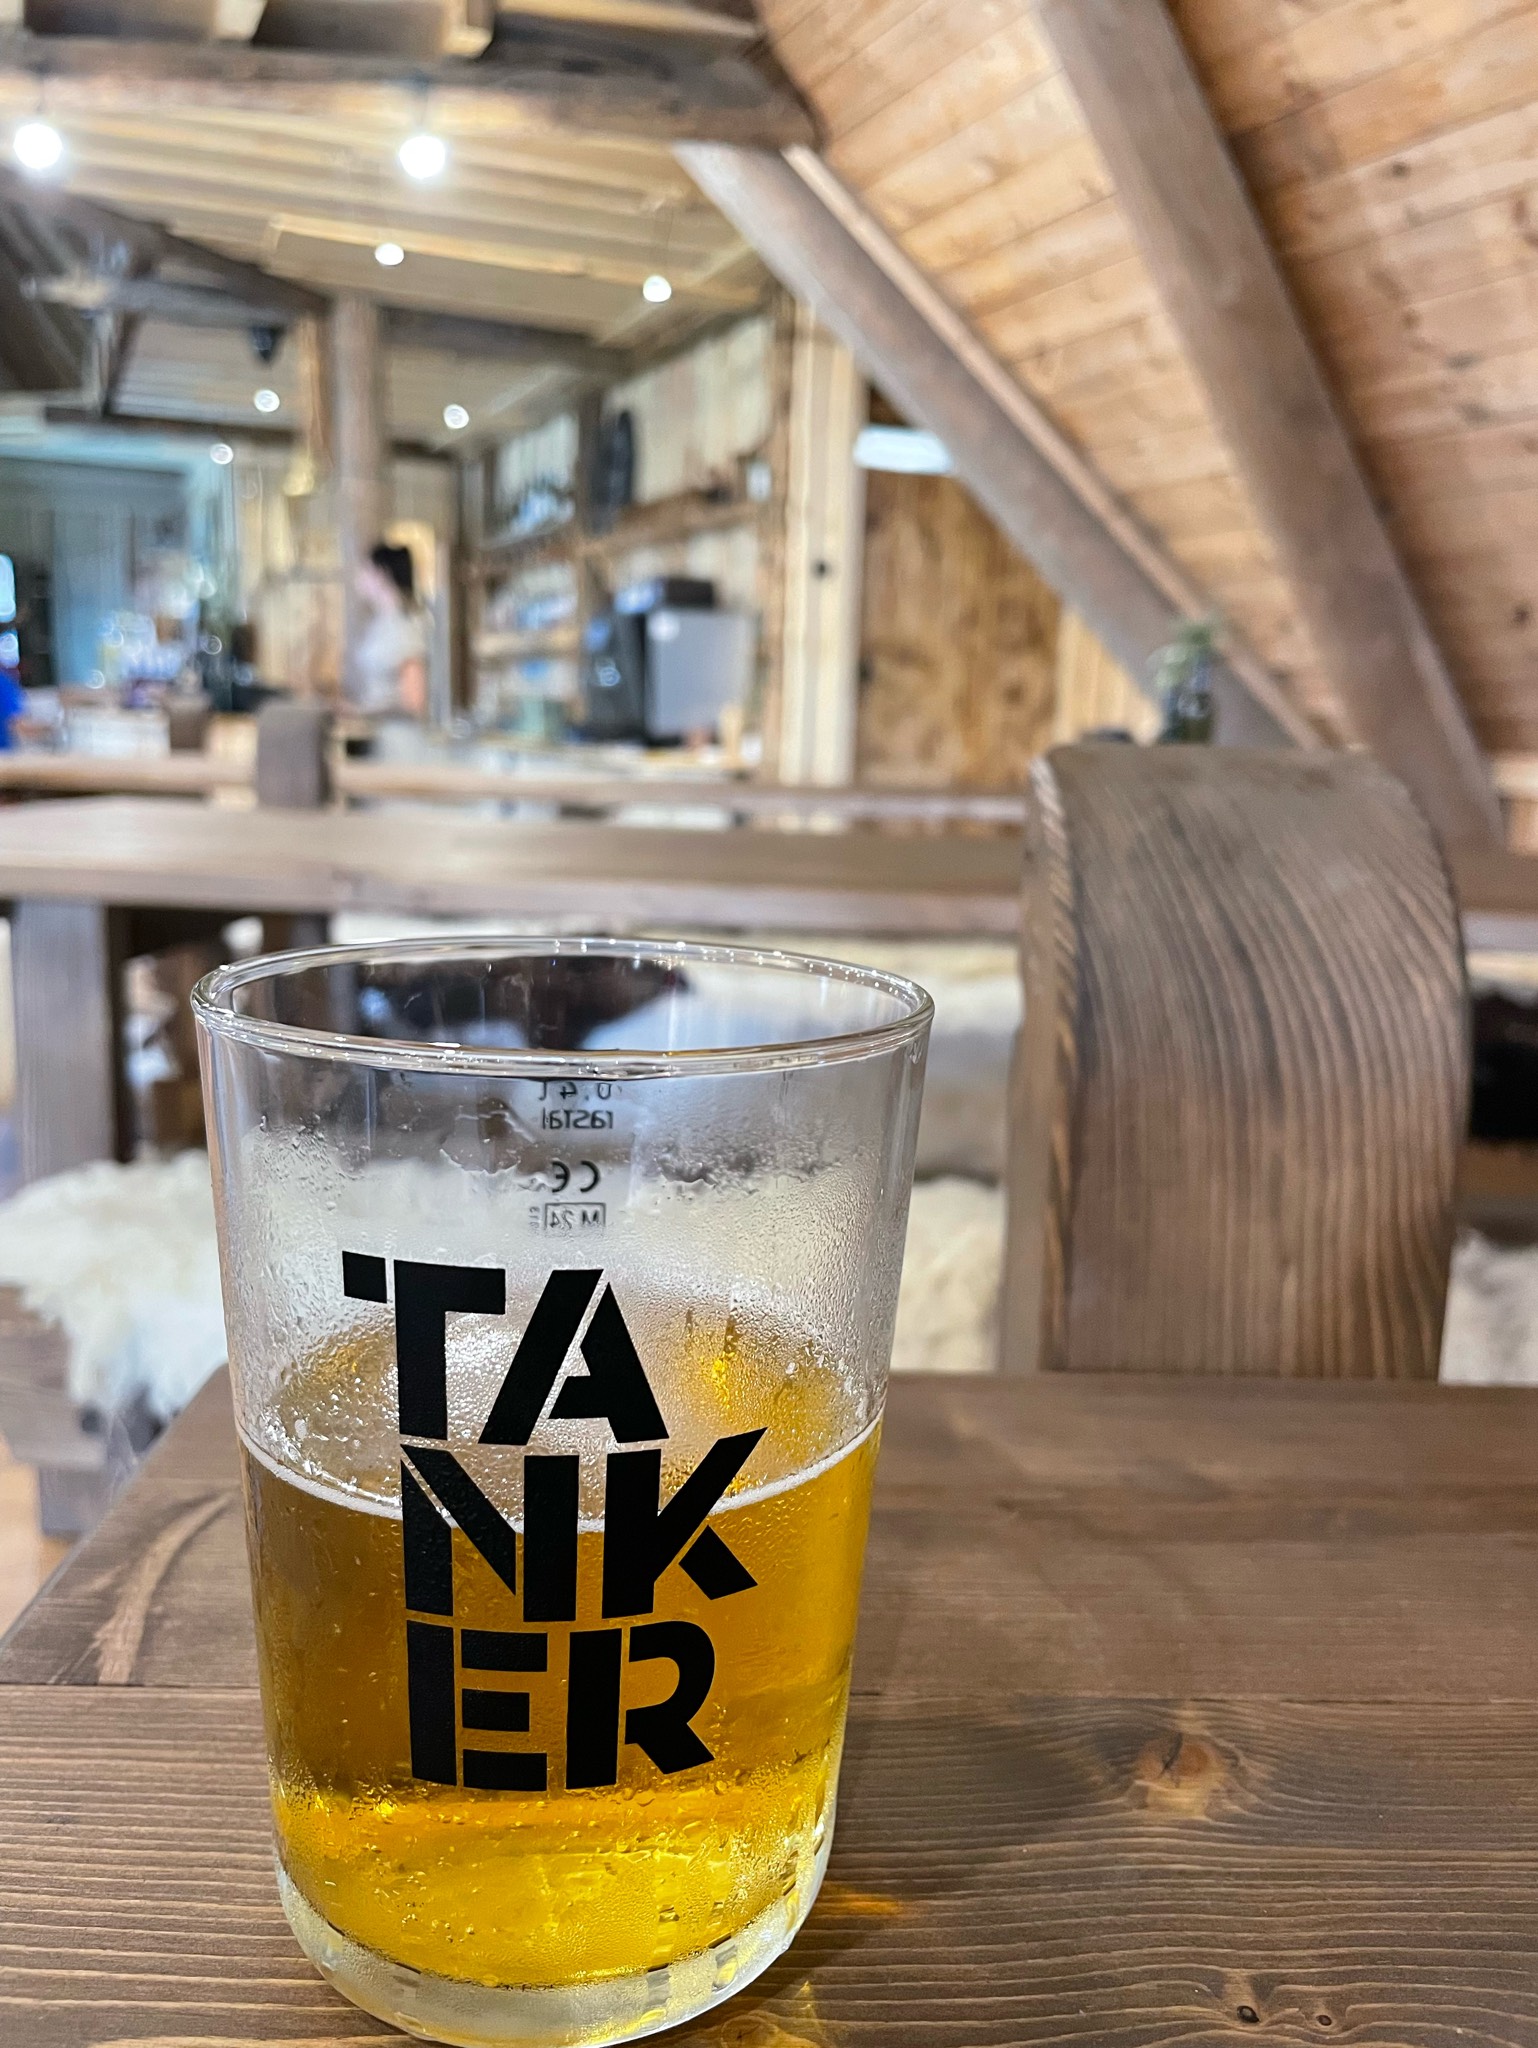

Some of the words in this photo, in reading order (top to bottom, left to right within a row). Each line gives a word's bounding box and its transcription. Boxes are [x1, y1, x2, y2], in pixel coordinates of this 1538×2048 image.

[342, 1251, 669, 1446] TA
[400, 1427, 768, 1622] NK
[406, 1620, 716, 1792] ER
